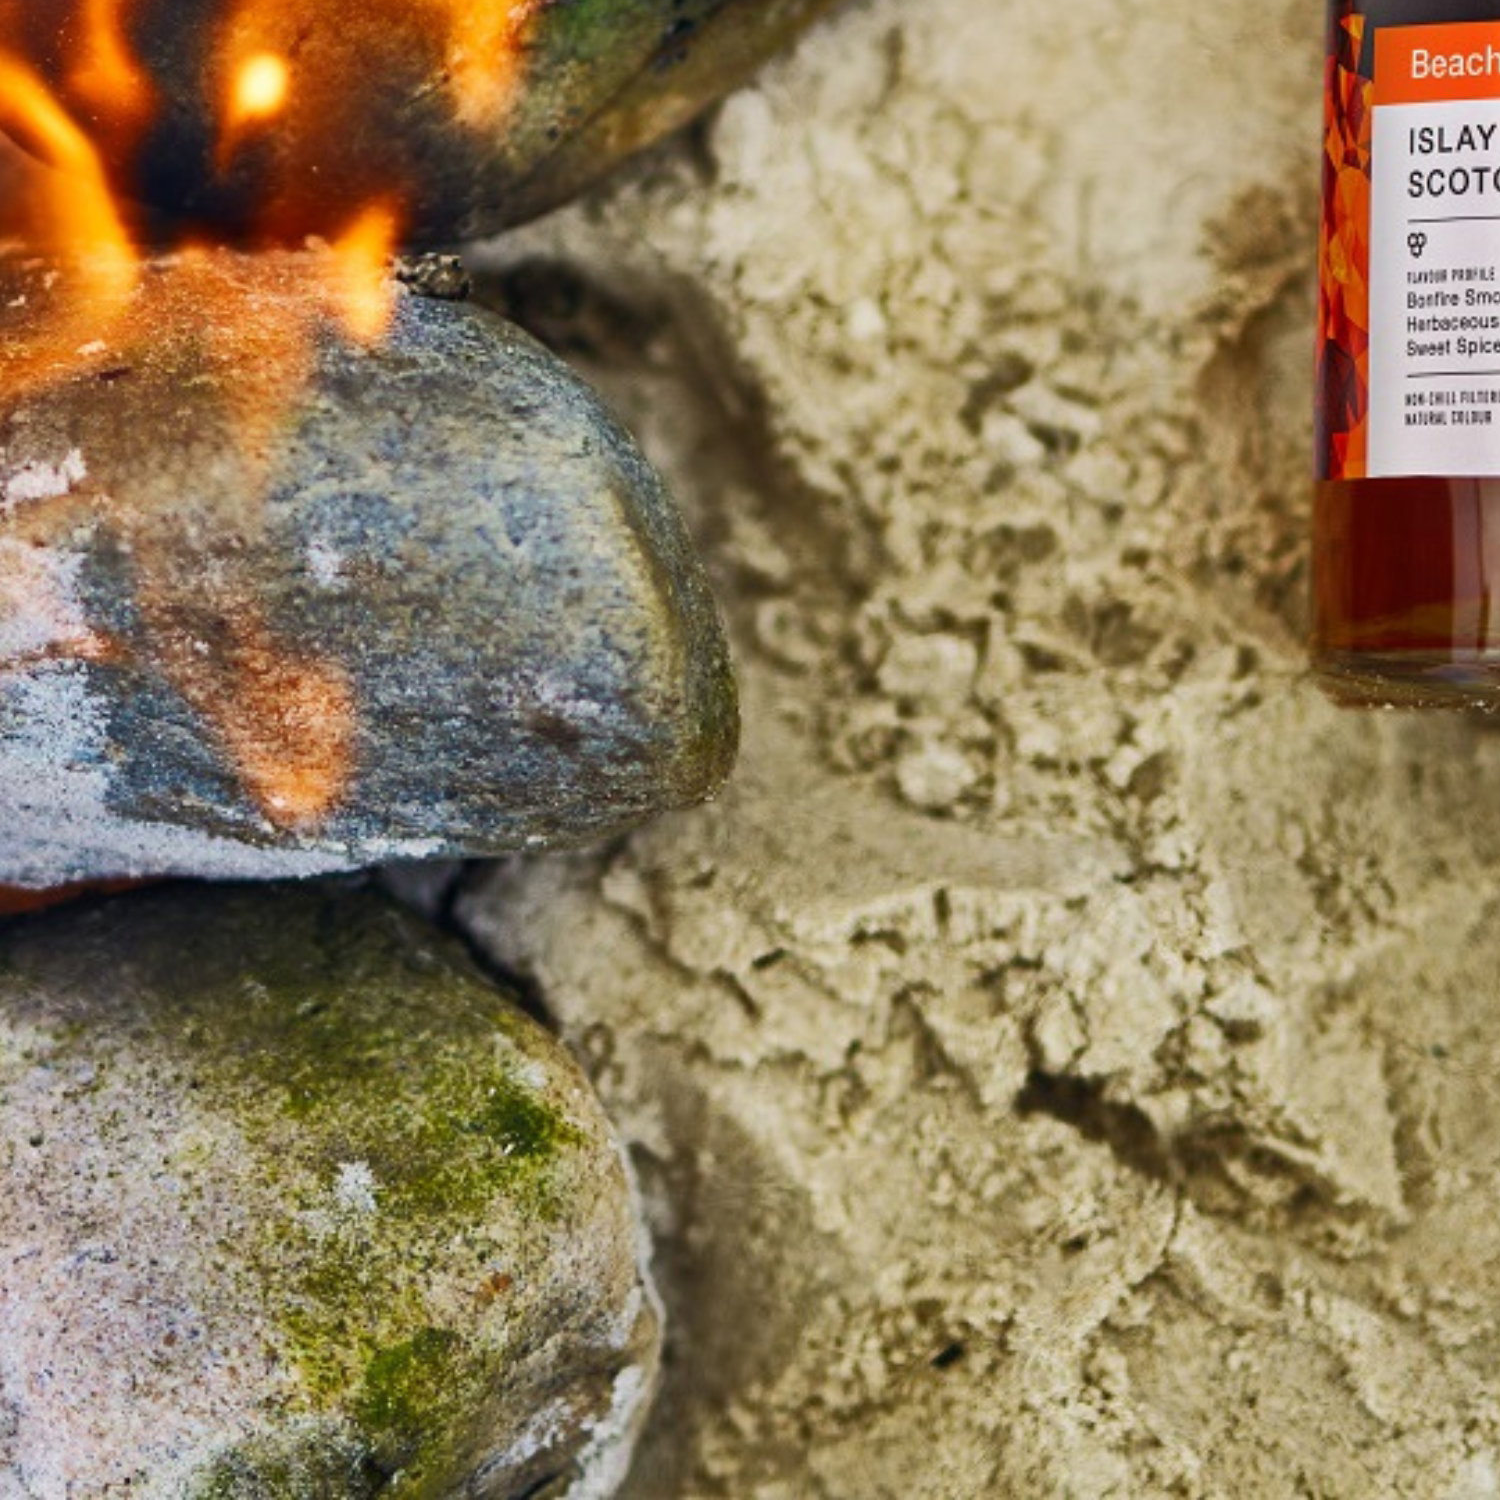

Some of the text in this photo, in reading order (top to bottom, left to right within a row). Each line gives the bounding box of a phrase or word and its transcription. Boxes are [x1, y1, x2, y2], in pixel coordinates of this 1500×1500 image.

[1409, 124, 1497, 154] ISLAY
[1407, 267, 1495, 284] FLAVOUR PROFILE
[1407, 290, 1460, 309] Bonfire
[1407, 315, 1500, 333] Herbaceous
[1407, 340, 1451, 356] Sweet
[1405, 410, 1492, 426] NATURAL COLOUR
